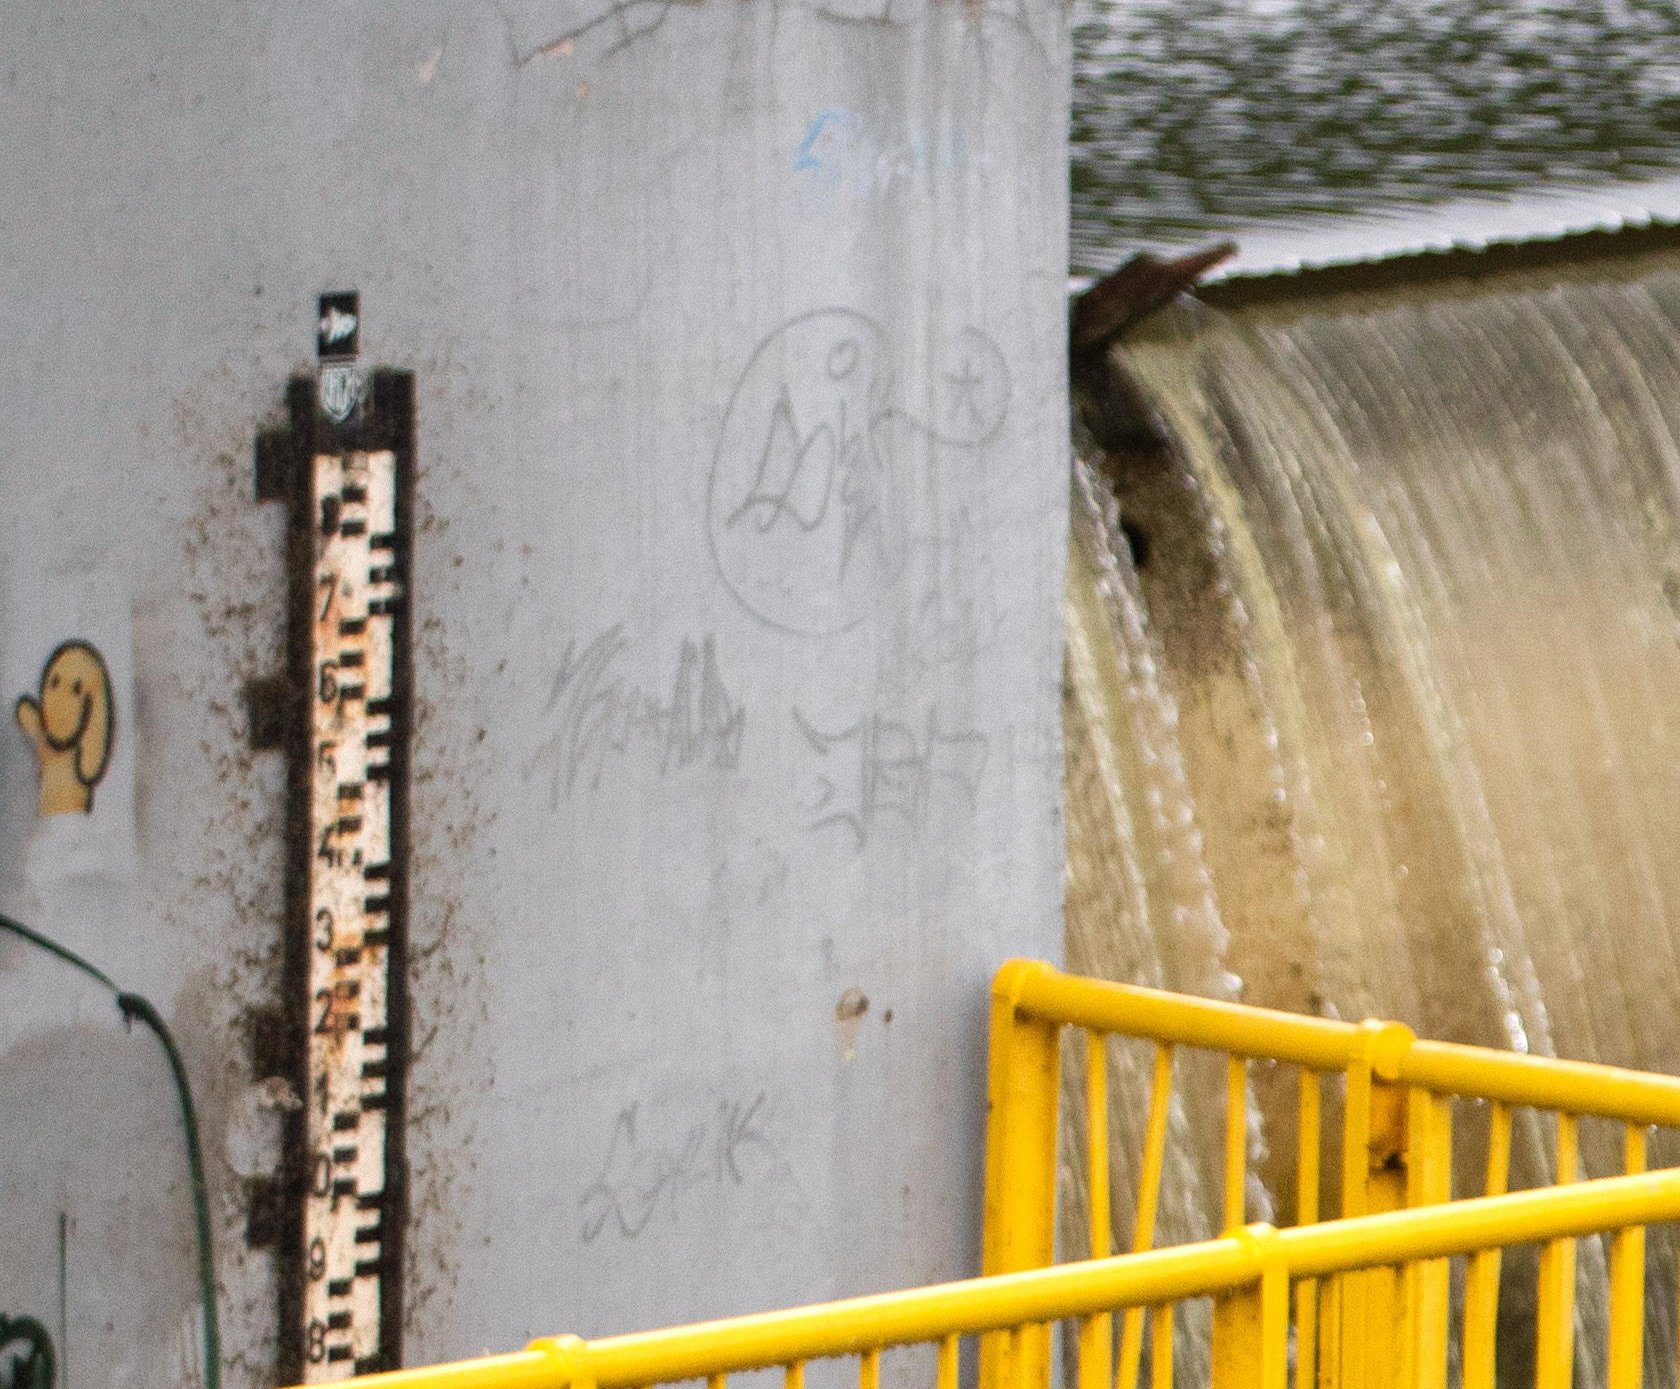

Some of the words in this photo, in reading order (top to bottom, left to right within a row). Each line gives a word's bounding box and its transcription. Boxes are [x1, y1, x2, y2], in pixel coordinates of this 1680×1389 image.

[319, 572, 337, 622] 7
[319, 660, 339, 703] 6
[315, 907, 333, 951] 3
[314, 989, 336, 1034] 2
[313, 1153, 330, 1198] 0
[307, 1237, 325, 1280] 9
[307, 1318, 324, 1363] 8
